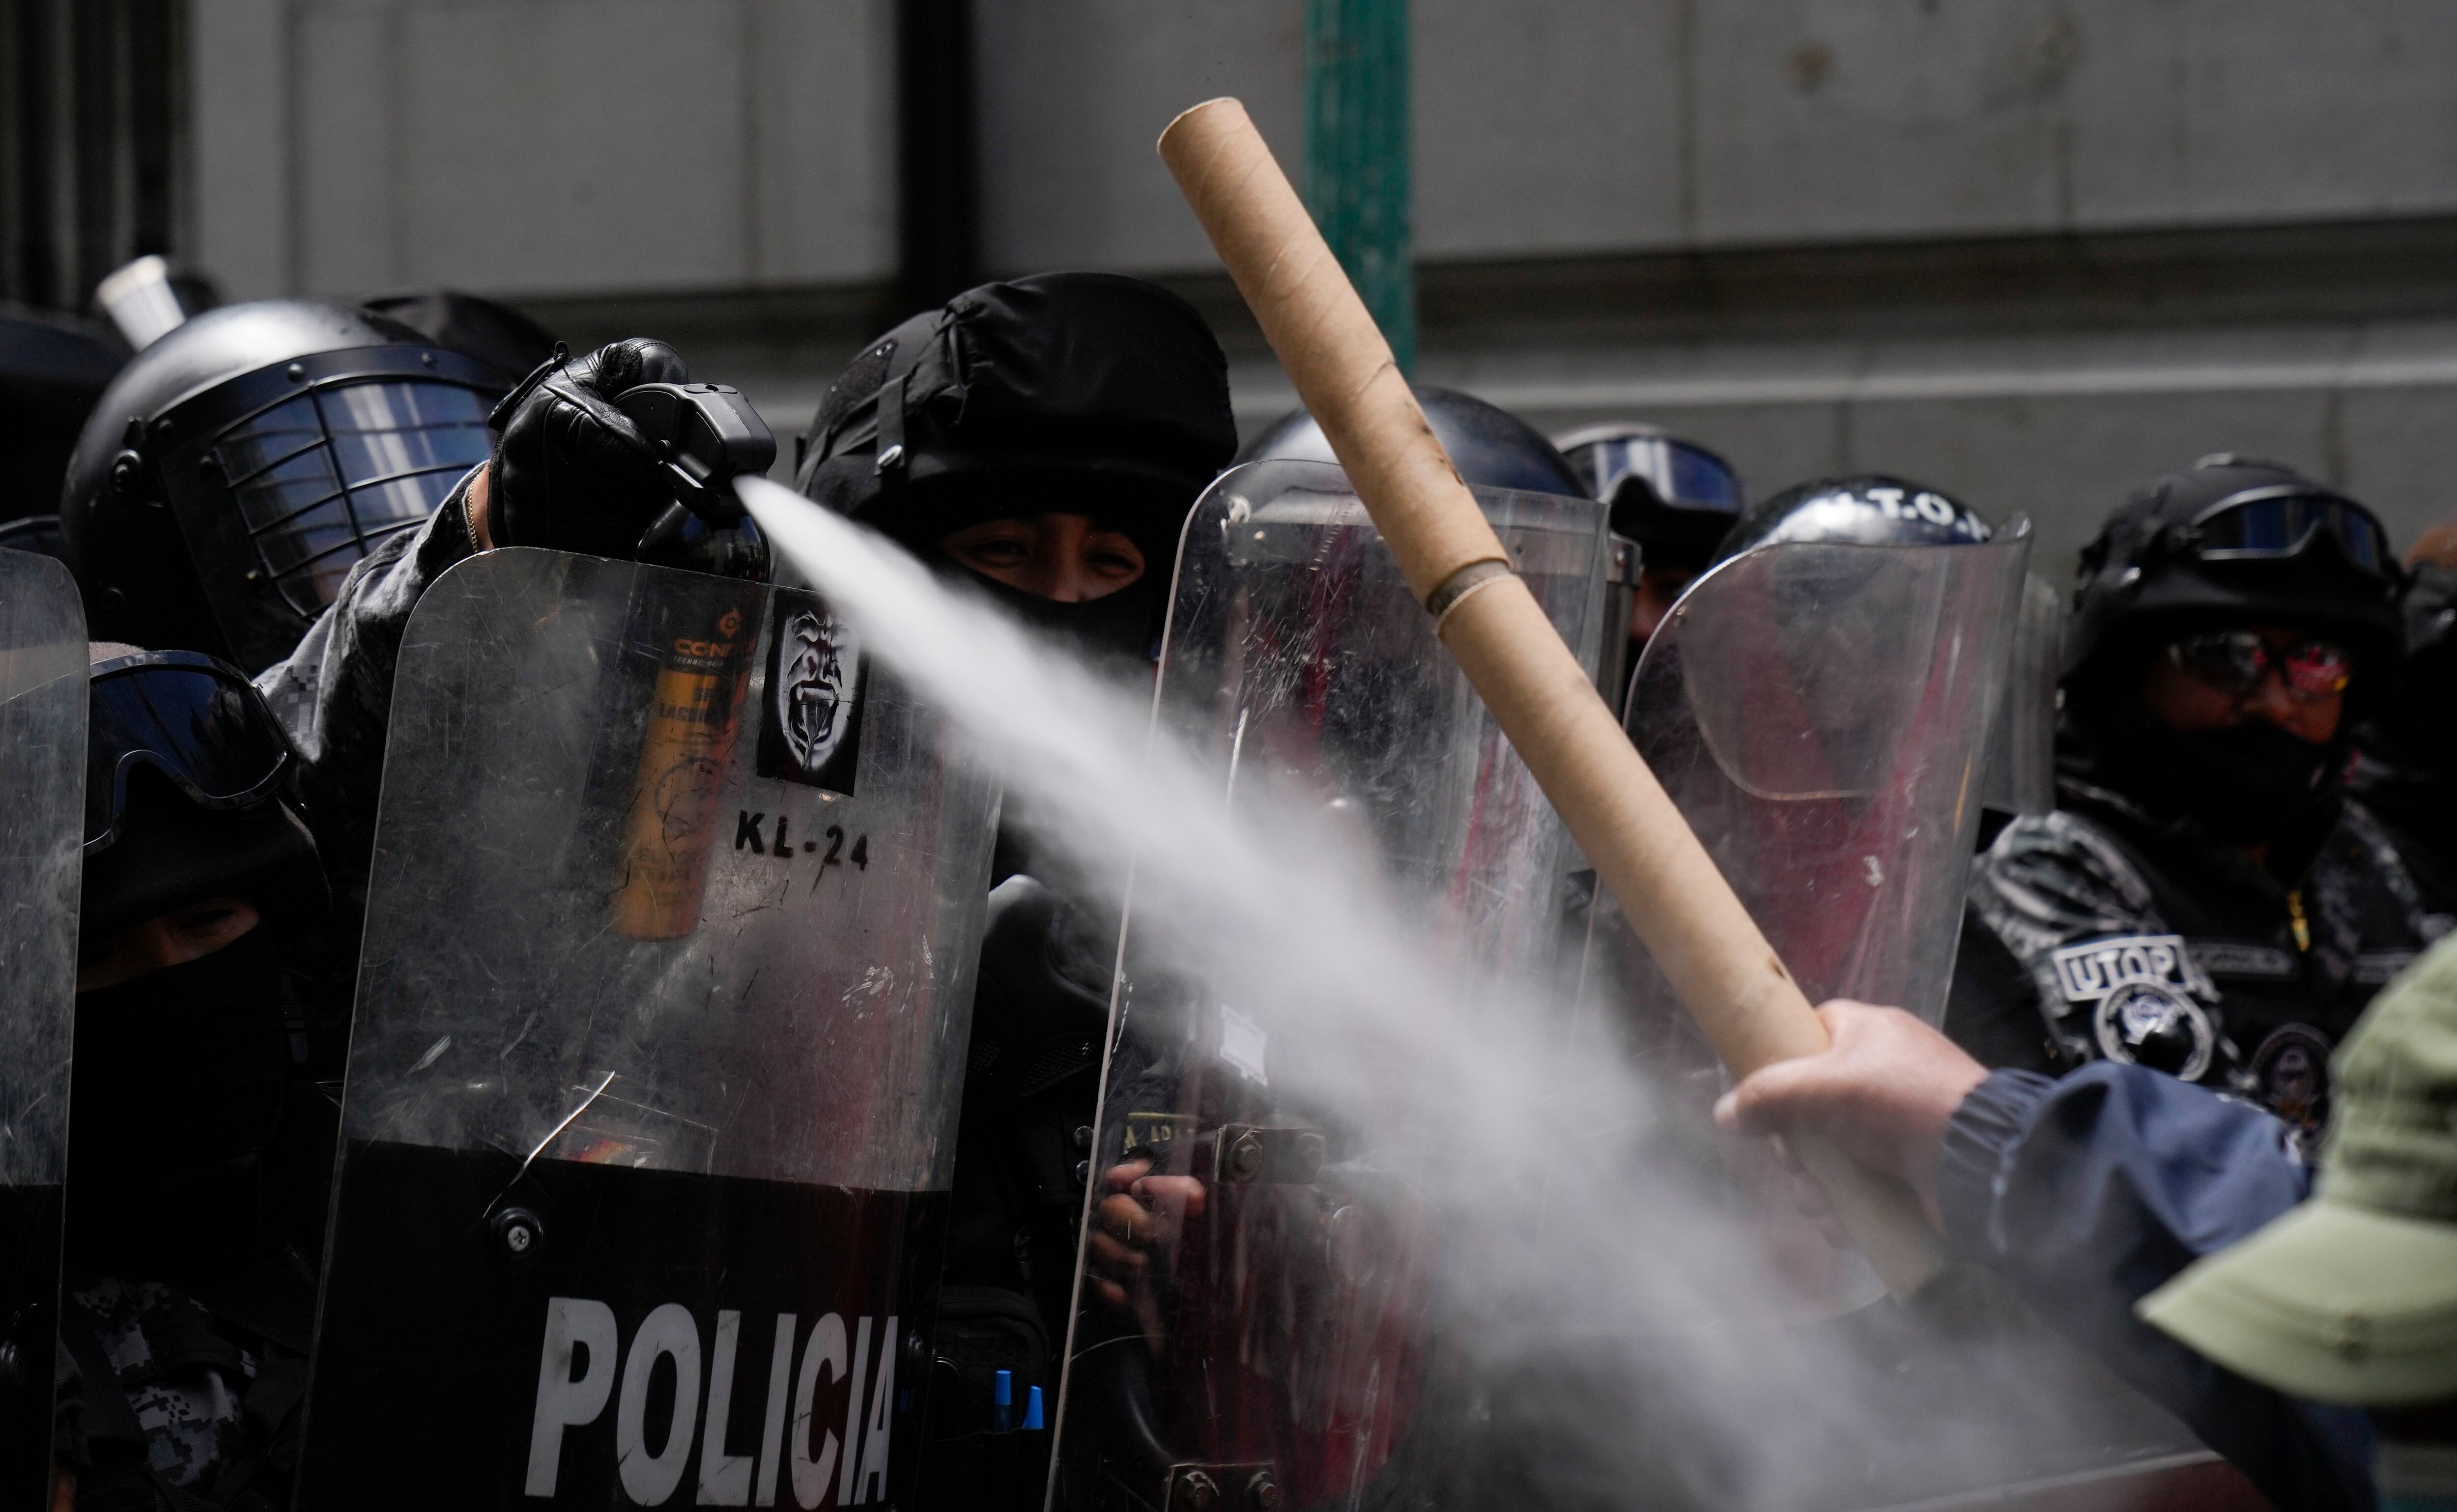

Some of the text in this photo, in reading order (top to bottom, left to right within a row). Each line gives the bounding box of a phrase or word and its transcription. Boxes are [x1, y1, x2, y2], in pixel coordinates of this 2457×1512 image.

[735, 810, 868, 871] KL-24
[2069, 945, 2175, 992] UTOP
[524, 1297, 898, 1511] POLICIA
